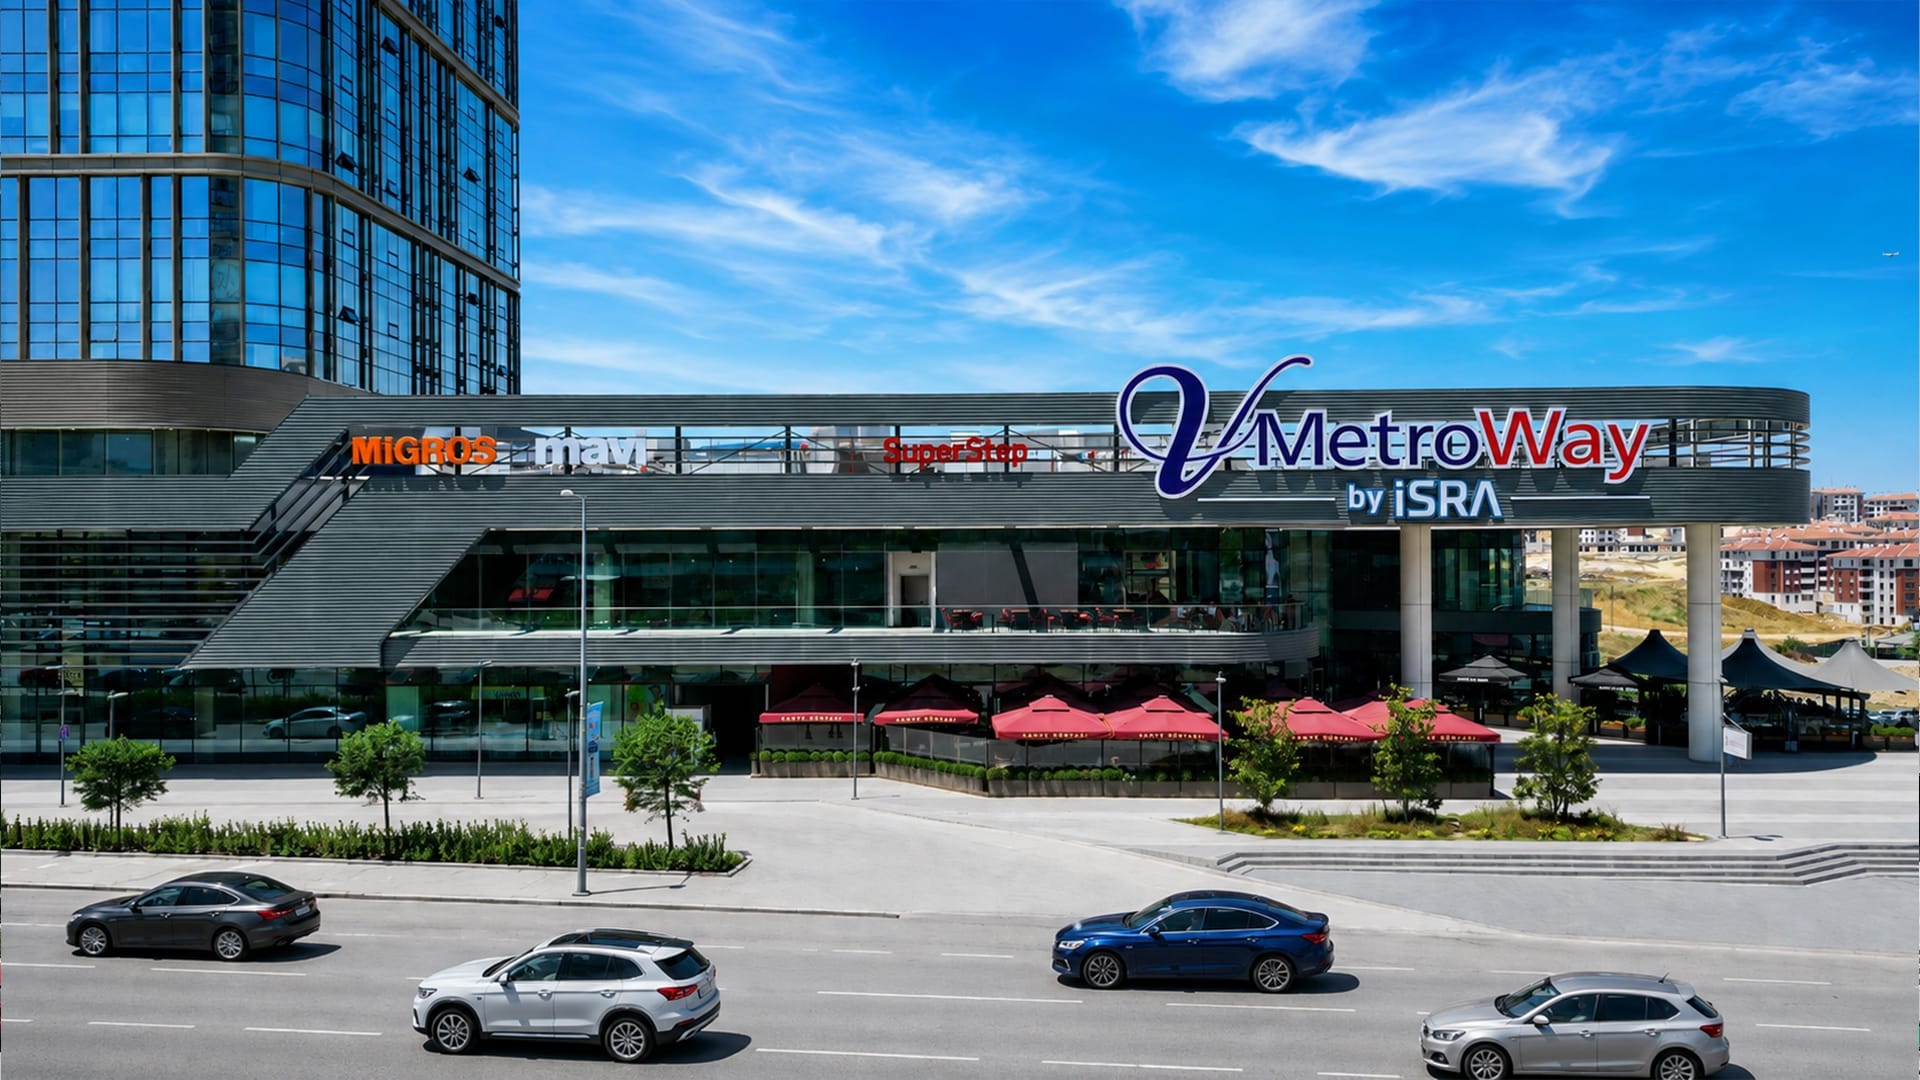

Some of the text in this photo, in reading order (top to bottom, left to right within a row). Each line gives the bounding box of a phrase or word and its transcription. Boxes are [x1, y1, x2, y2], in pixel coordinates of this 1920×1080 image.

[535, 430, 647, 465] mavi
[883, 436, 1028, 472] SuperStep
[1251, 407, 1650, 483] MetroWay
[1347, 483, 1385, 515] by
